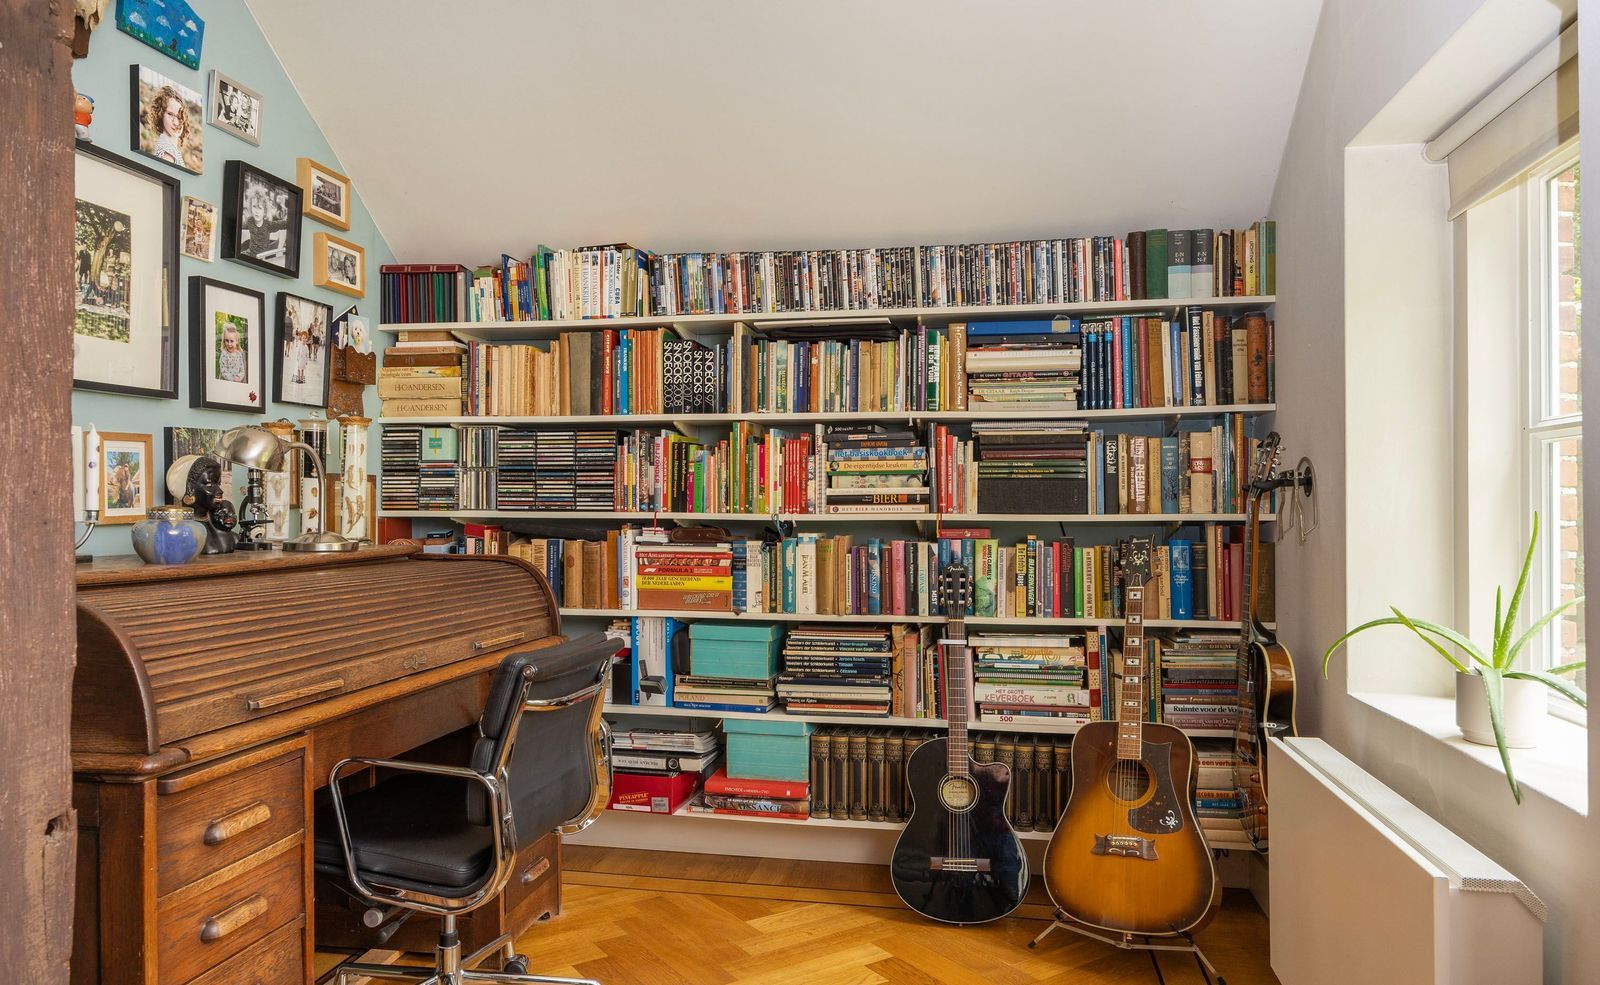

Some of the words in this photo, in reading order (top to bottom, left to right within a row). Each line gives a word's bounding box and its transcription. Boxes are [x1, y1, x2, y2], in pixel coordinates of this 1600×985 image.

[582, 268, 590, 306] FRANKRIJK
[1192, 316, 1200, 326] Het
[928, 344, 934, 352] IN
[664, 342, 672, 384] SNOECKS
[673, 342, 682, 384] SNOECKS
[683, 341, 692, 383] SNOECKS
[928, 354, 934, 364] DE
[694, 350, 702, 394] SNOECKS
[705, 351, 714, 394] SNOECKS
[664, 385, 672, 408] 2005
[673, 385, 682, 407] 2008
[683, 384, 692, 402] 2017
[694, 394, 702, 407] 96
[705, 394, 714, 407] 97
[849, 448, 908, 457] basiskookboek
[1135, 438, 1144, 458] KIRST
[1136, 464, 1146, 502] REEMAN
[873, 494, 898, 504] BIER
[534, 544, 544, 554] JAN
[984, 694, 1035, 703] KEVERBOEK
[619, 793, 649, 801] PINEAPPLE
[716, 802, 781, 812] RENAISSANCE
